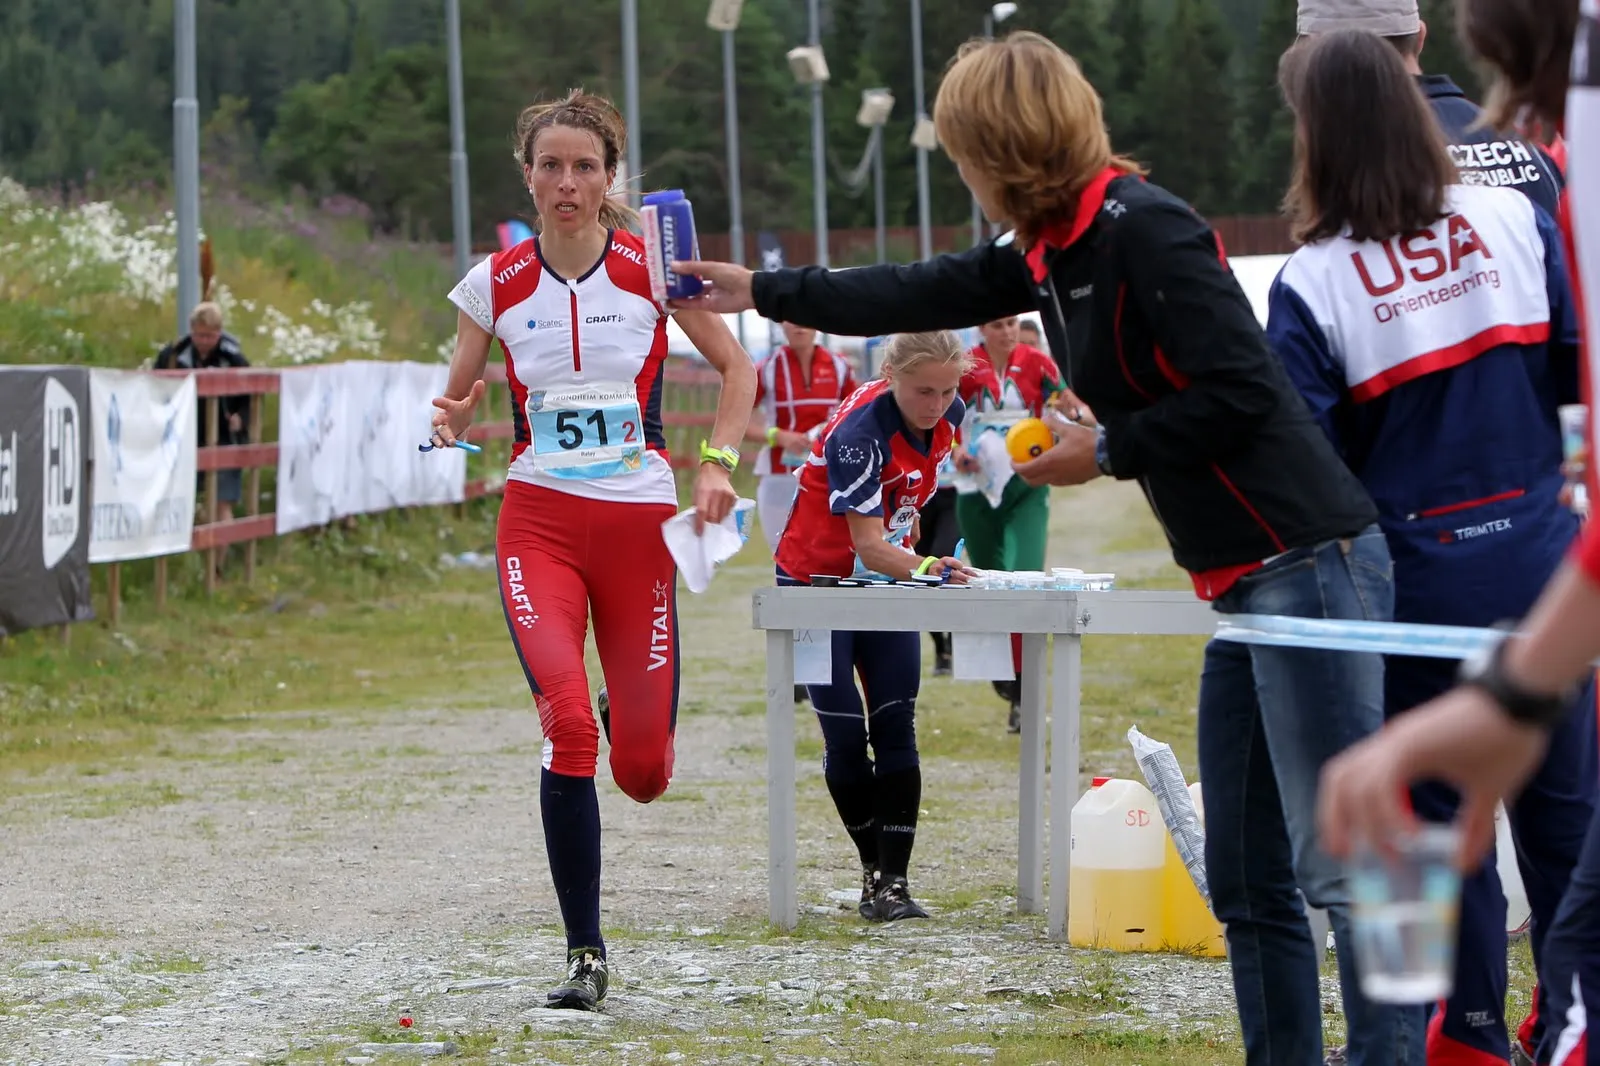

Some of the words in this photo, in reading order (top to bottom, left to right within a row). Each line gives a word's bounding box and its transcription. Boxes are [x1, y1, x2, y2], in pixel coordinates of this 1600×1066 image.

[1446, 140, 1532, 168] CZECH
[611, 240, 644, 266] VITAL
[1350, 214, 1494, 297] USA
[494, 258, 529, 284] VITAL
[1374, 269, 1501, 323] Orienteering
[537, 319, 563, 329] Scatec
[585, 314, 617, 324] CRAFT
[556, 409, 609, 450] 51
[622, 421, 637, 443] 2
[48, 407, 74, 506] HD
[1454, 517, 1513, 540] TRIMTEX
[506, 556, 534, 613] CRAFT
[646, 600, 668, 672] VITAL
[883, 824, 916, 834] nonam
[1125, 809, 1151, 827] SD
